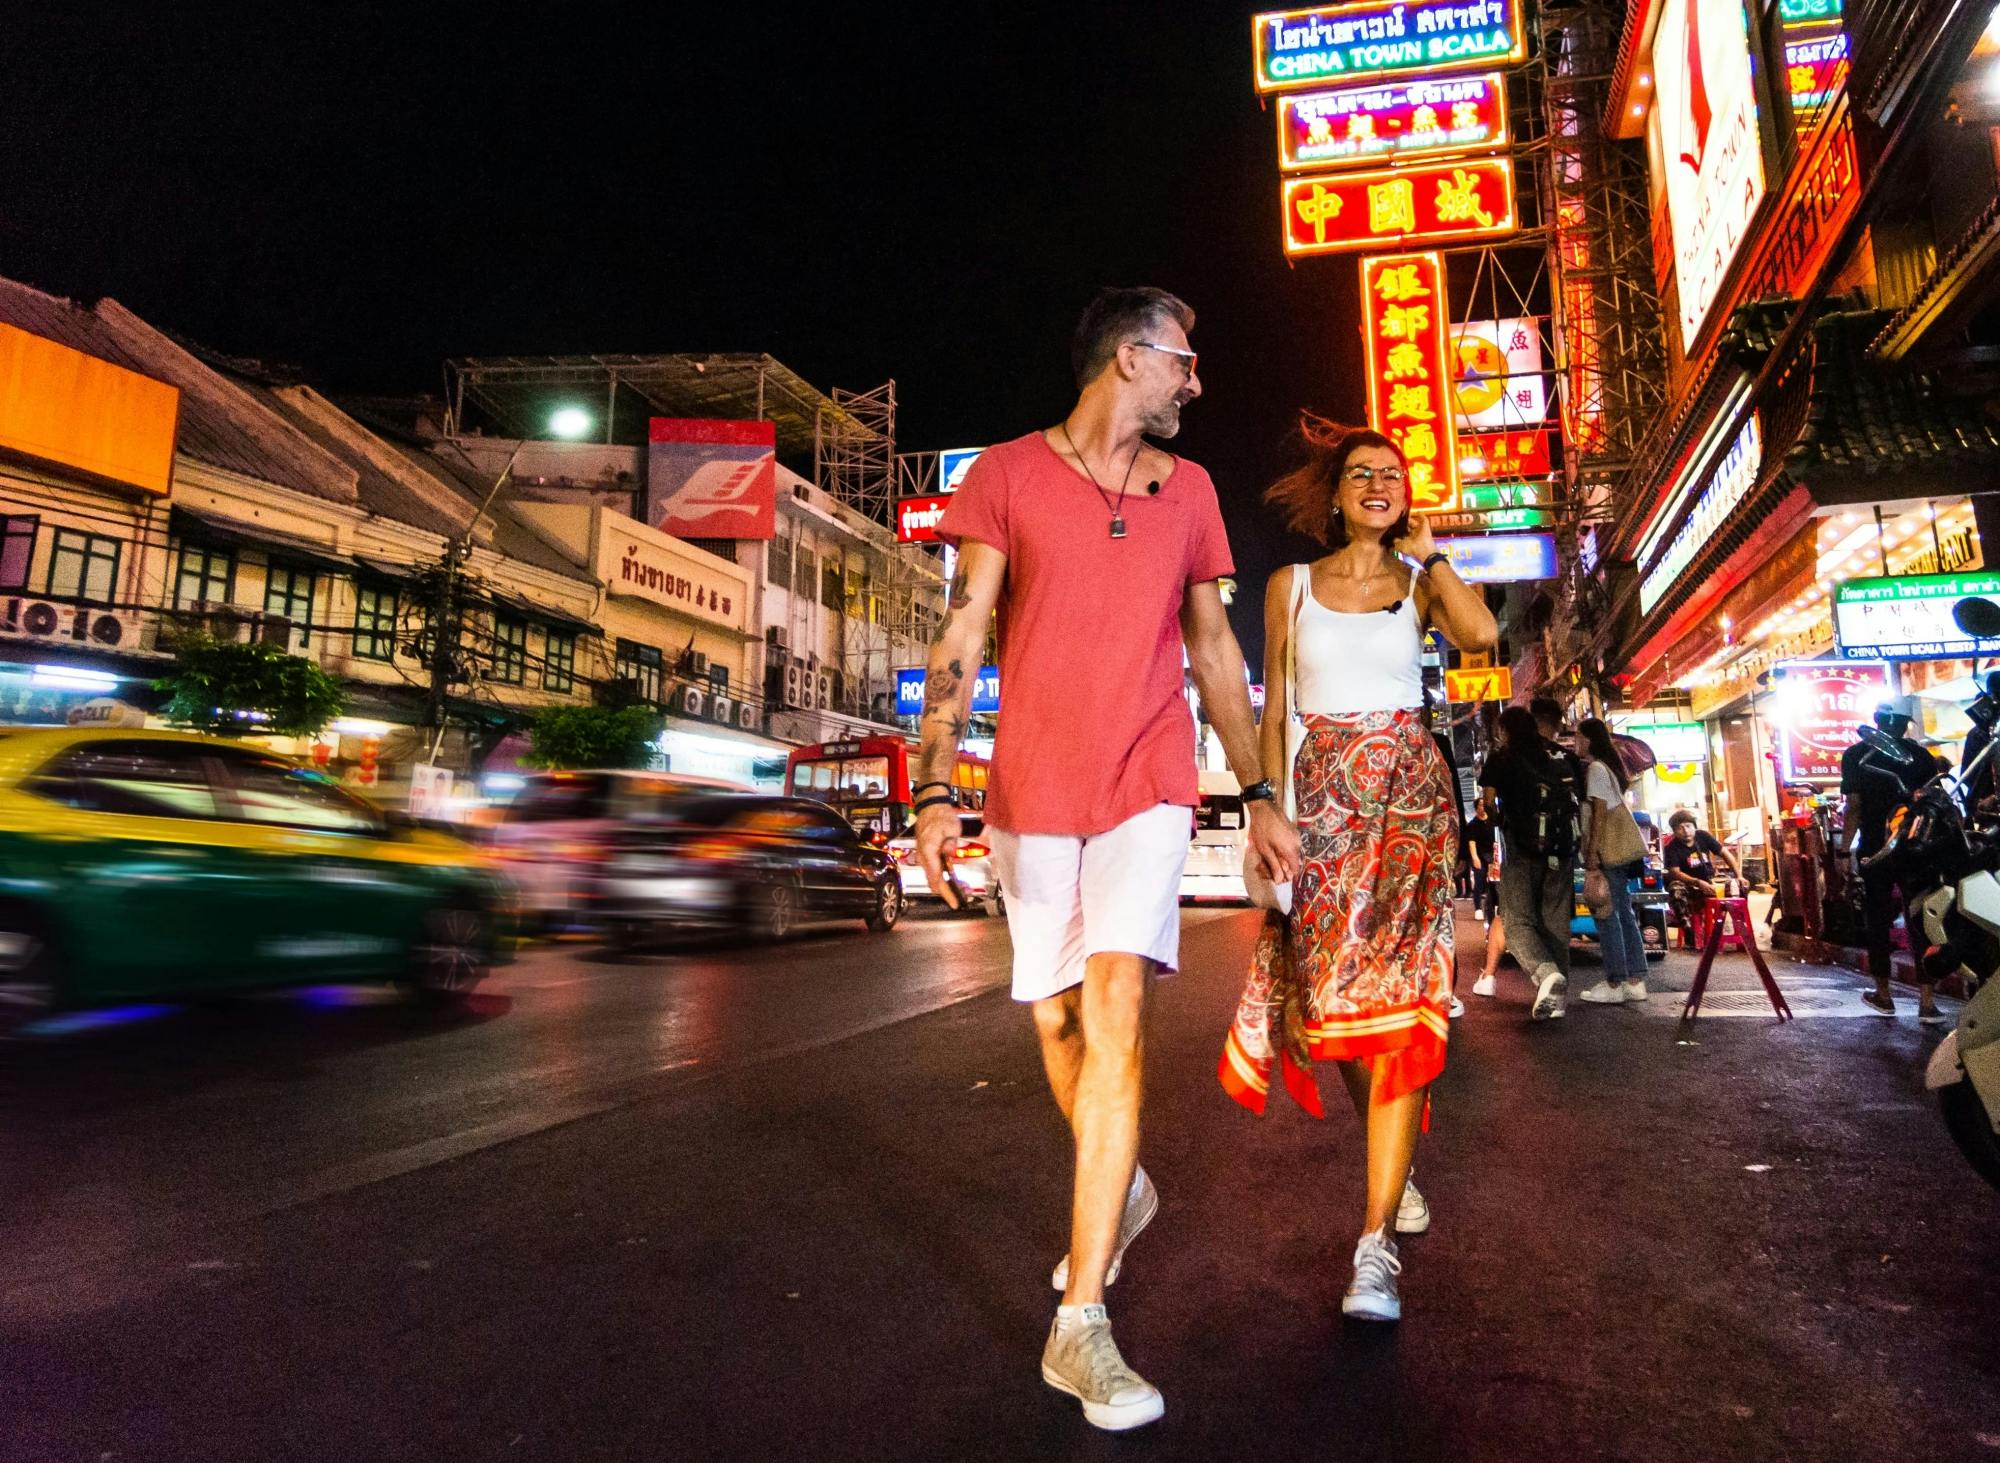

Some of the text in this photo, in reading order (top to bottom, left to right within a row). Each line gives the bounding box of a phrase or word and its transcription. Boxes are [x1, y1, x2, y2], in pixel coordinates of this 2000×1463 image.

[1270, 30, 1510, 78] CHINA TOWN SCALA
[1296, 169, 1493, 244] 中國城
[1429, 510, 1526, 527] BIRD NEST
[621, 545, 692, 603] ห้างขายยา
[1848, 646, 1878, 658] CHINA
[1880, 645, 1910, 656] TOWN
[1911, 643, 1944, 655] SCALA
